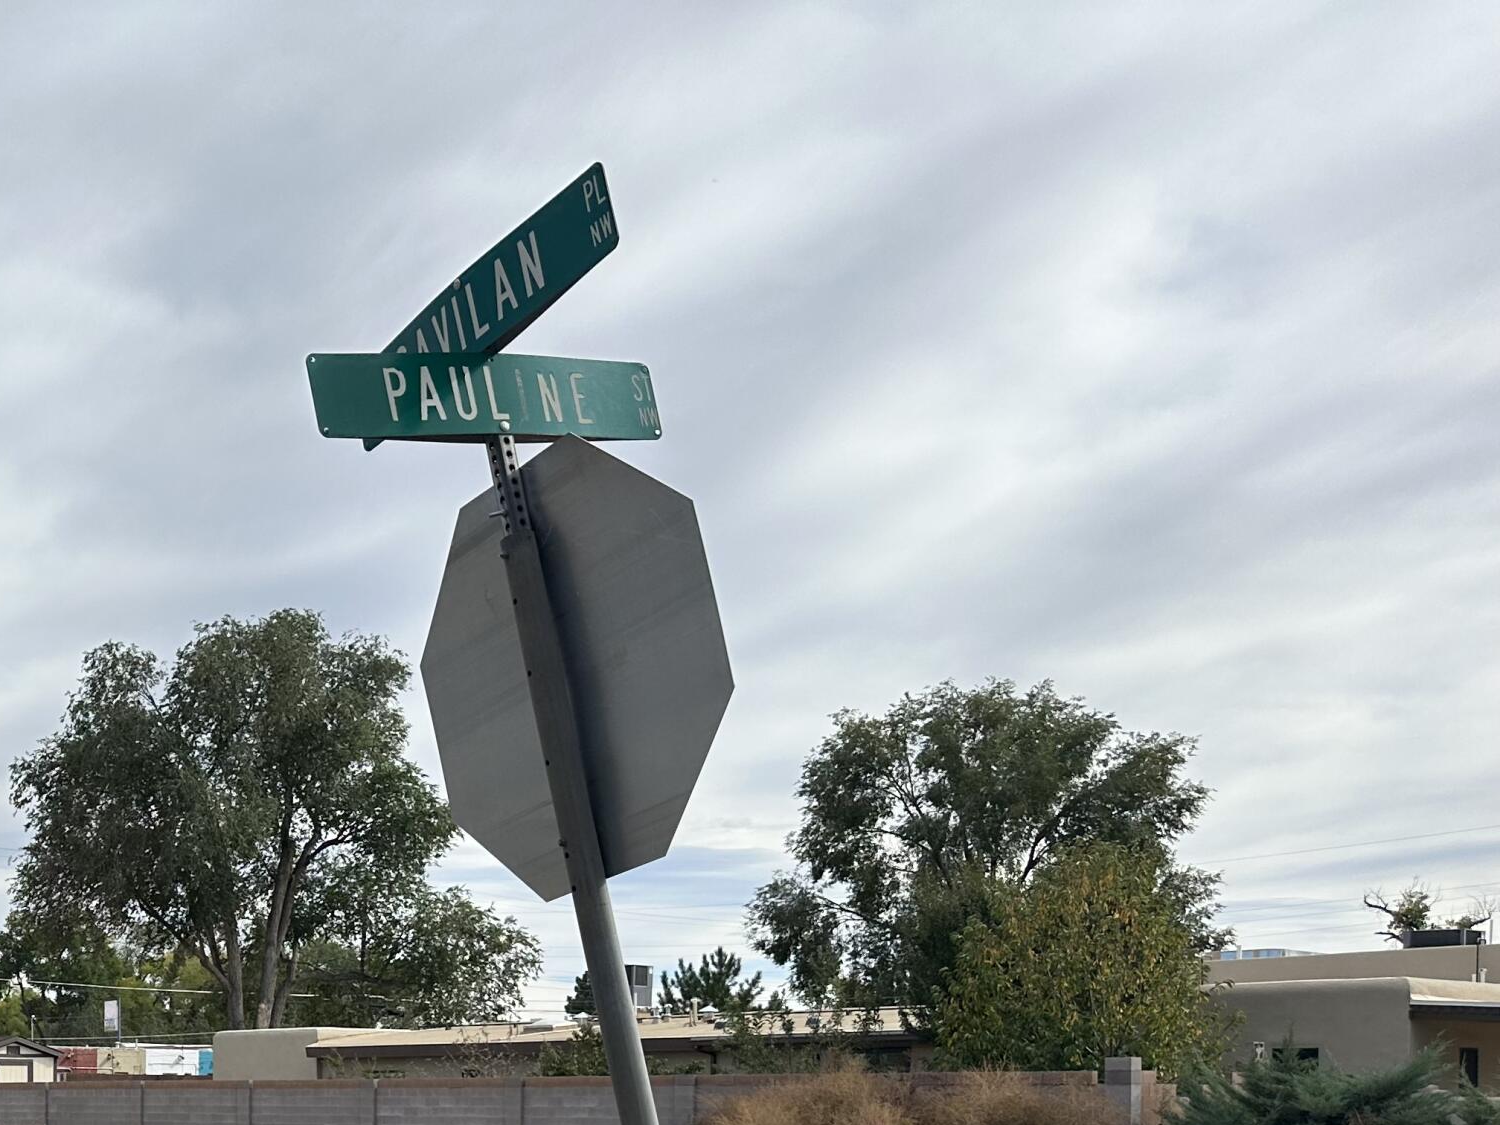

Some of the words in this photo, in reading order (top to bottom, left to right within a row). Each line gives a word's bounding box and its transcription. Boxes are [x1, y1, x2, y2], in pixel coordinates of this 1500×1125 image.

[590, 211, 612, 248] NW
[396, 231, 546, 353] AVILAN
[583, 175, 606, 213] PL
[383, 365, 595, 425] PAULINE
[631, 372, 651, 401] ST
[639, 407, 659, 428] NW
